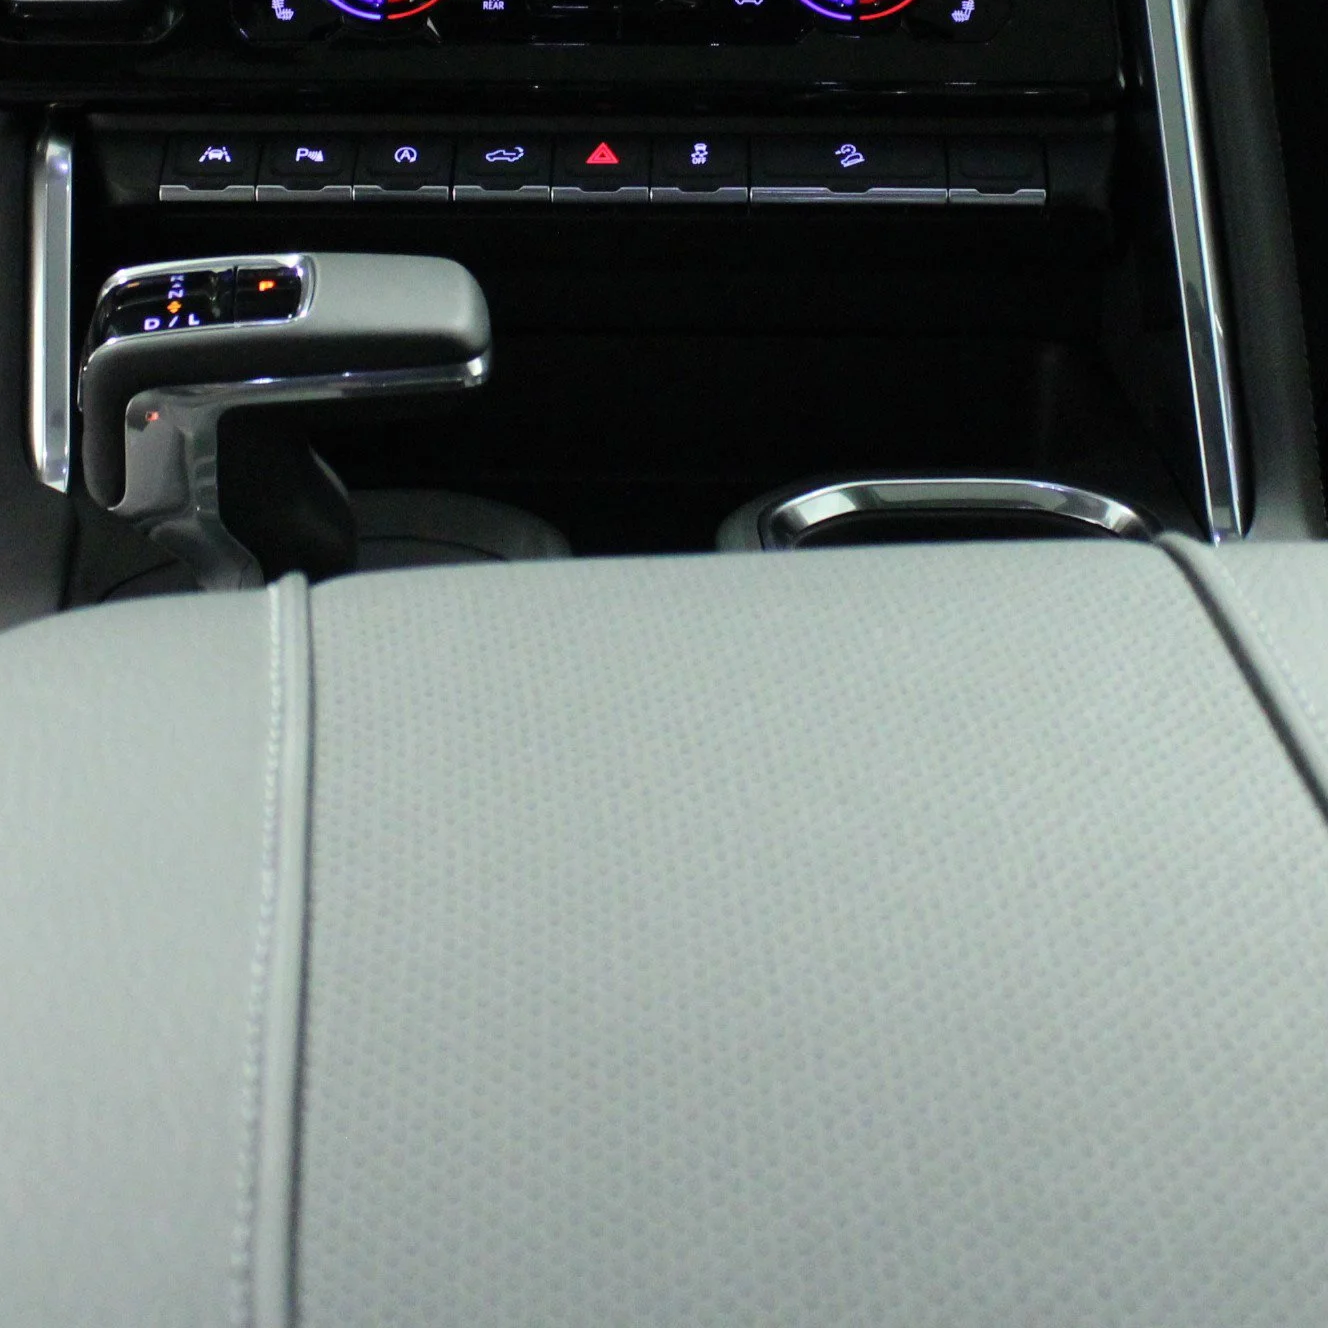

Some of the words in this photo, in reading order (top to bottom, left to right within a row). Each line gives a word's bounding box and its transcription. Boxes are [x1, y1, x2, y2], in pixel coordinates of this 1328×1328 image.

[483, 1, 505, 10] REAR
[259, 280, 276, 292] P
[144, 318, 161, 331] D
[188, 313, 201, 326] L
